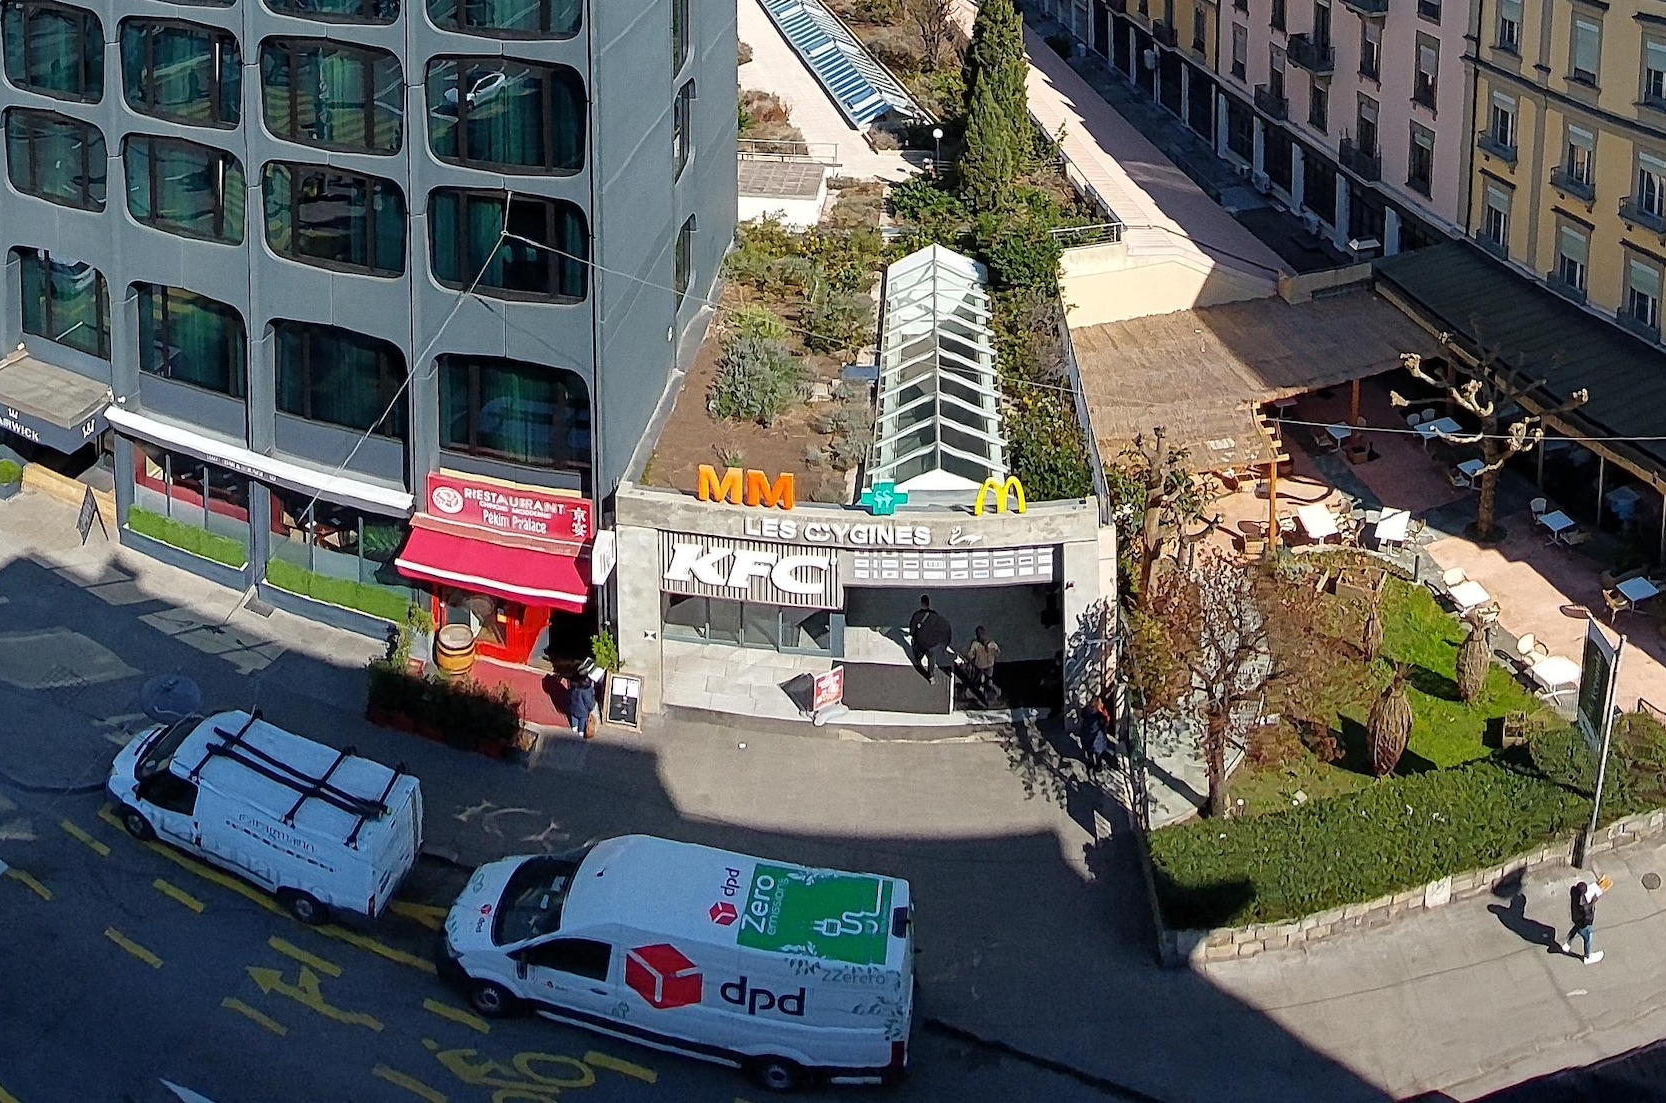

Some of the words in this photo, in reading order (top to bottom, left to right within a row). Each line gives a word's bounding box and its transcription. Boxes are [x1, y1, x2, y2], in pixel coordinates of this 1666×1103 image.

[697, 463, 795, 511] MM
[744, 515, 798, 539] LES
[662, 542, 830, 596] KFC
[720, 866, 741, 897] dpd
[740, 873, 776, 936] Zero
[719, 975, 807, 1017] dpd
